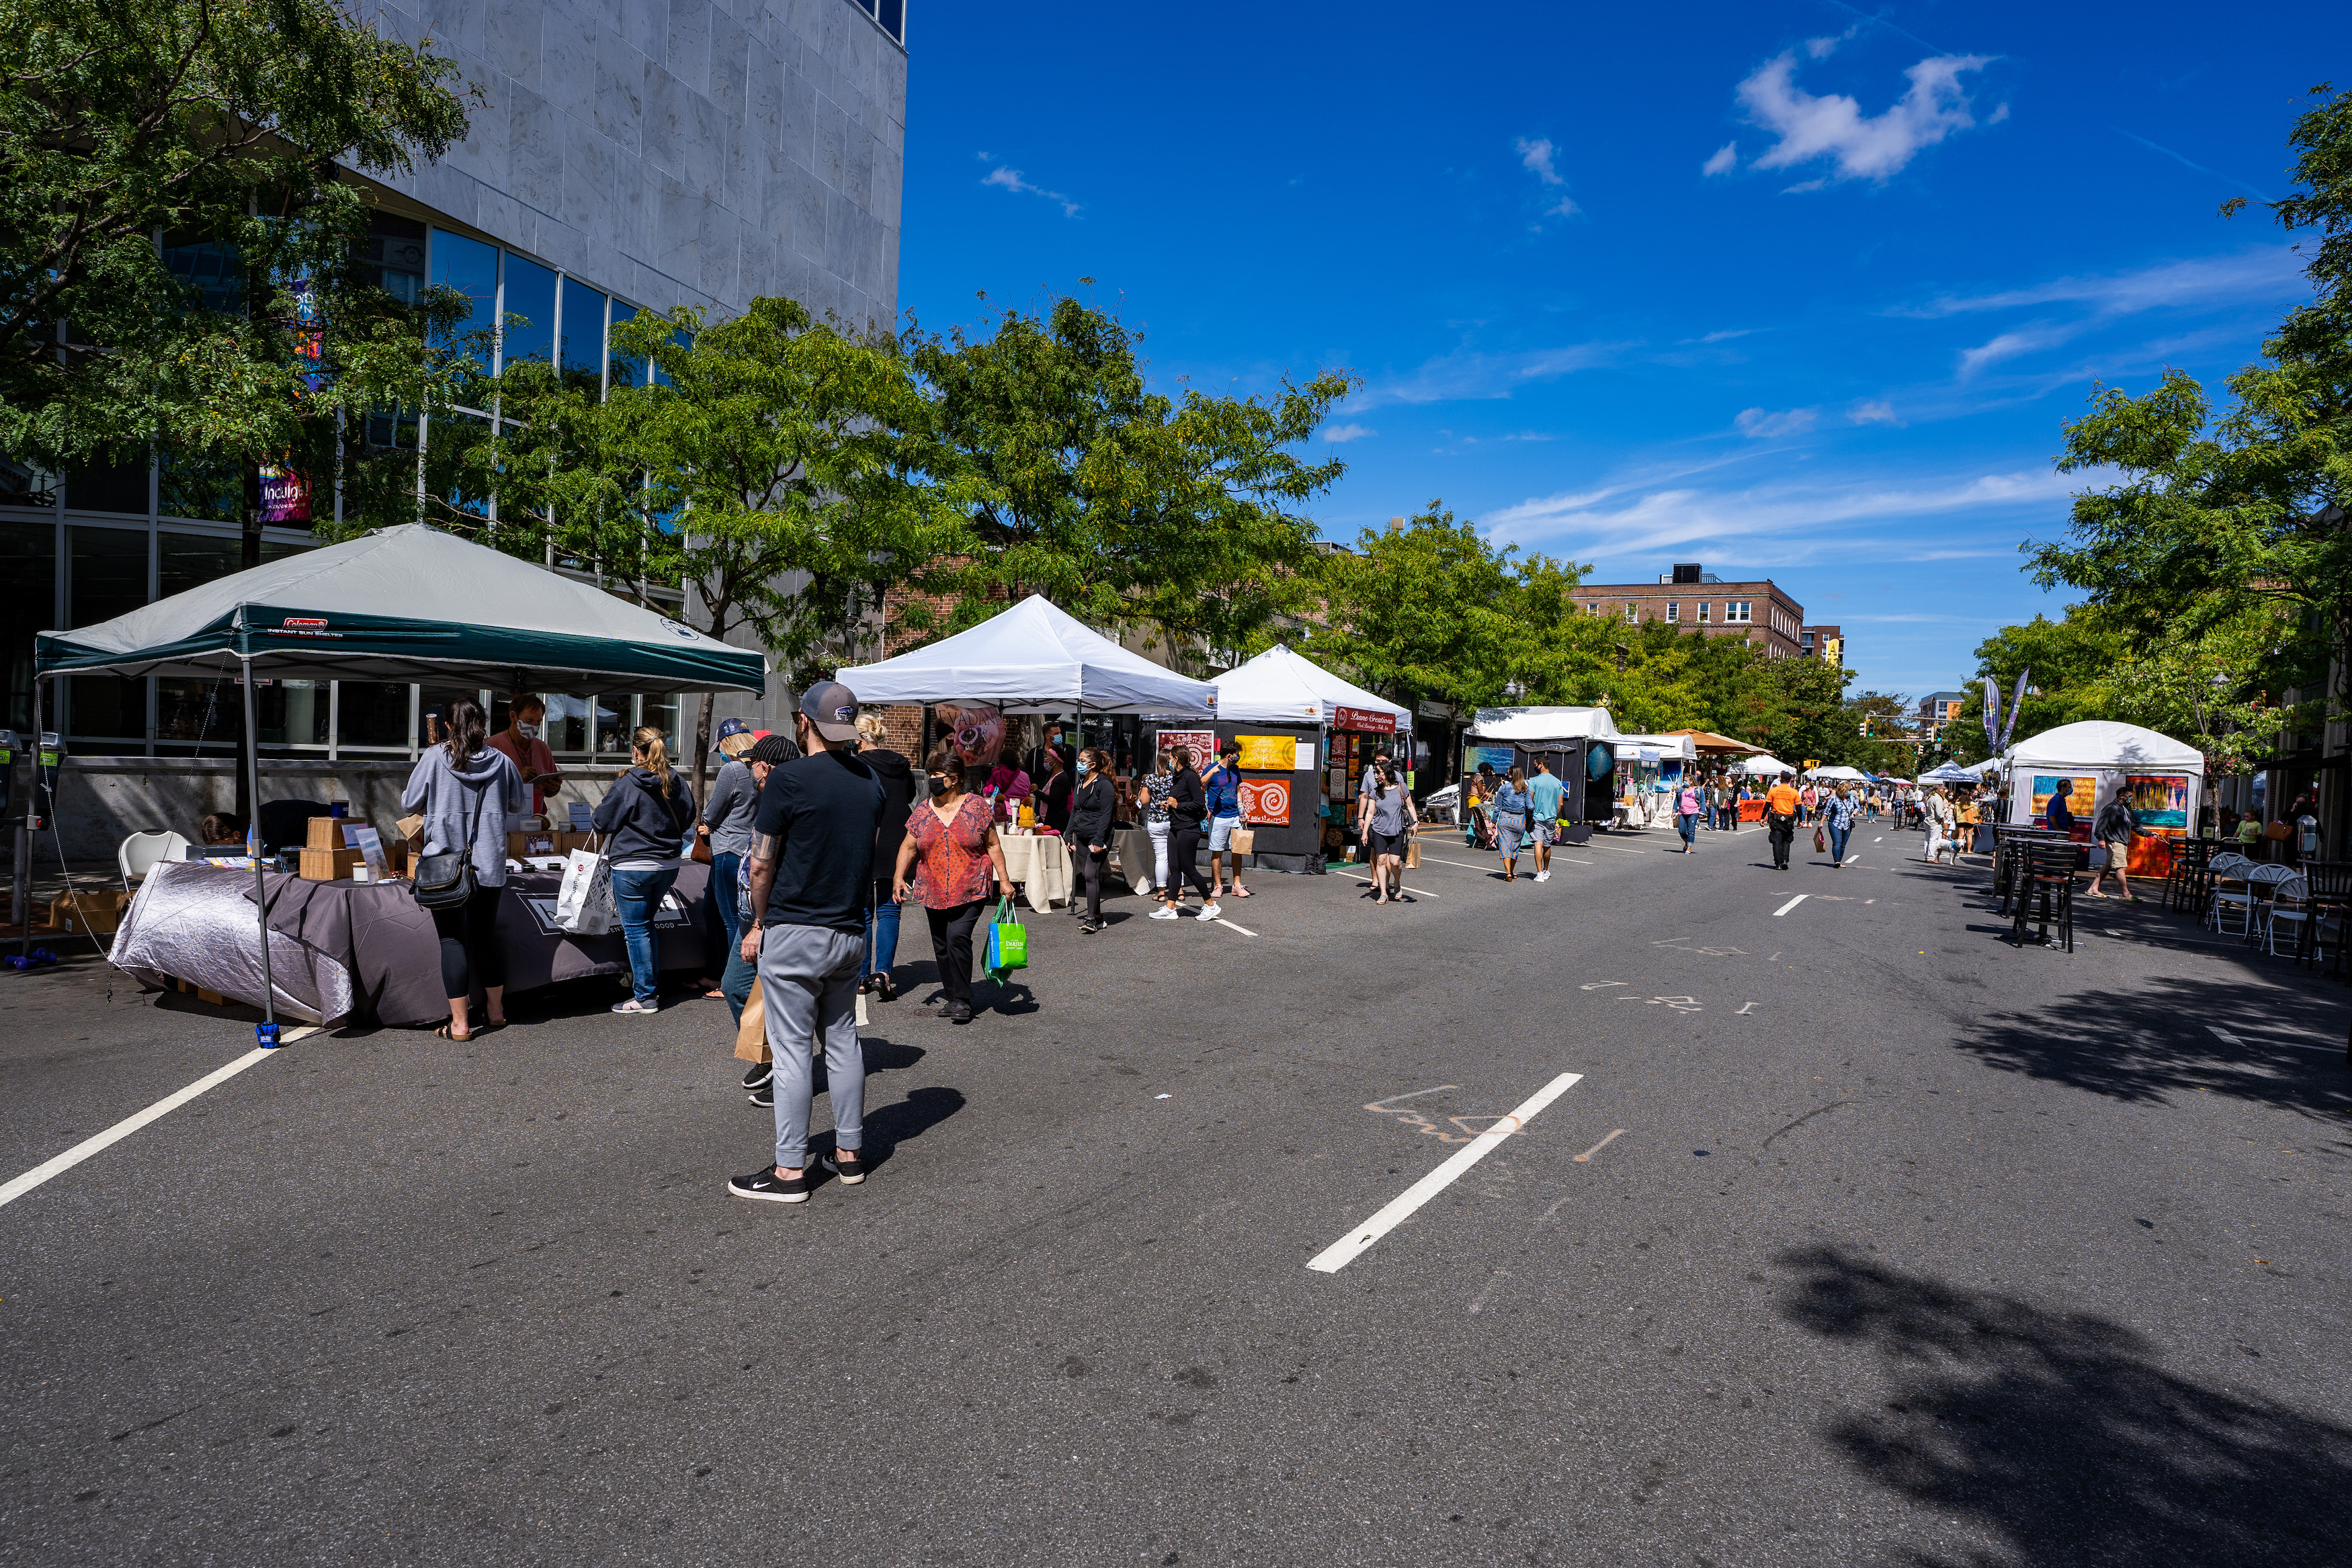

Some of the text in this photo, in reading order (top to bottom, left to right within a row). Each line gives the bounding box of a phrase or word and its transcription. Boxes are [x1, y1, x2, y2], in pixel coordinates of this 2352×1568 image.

[286, 619, 318, 629] Coleman
[938, 709, 1002, 726] EVADANE
[1369, 713, 1393, 724] Creations
[567, 873, 582, 902] lululemon
